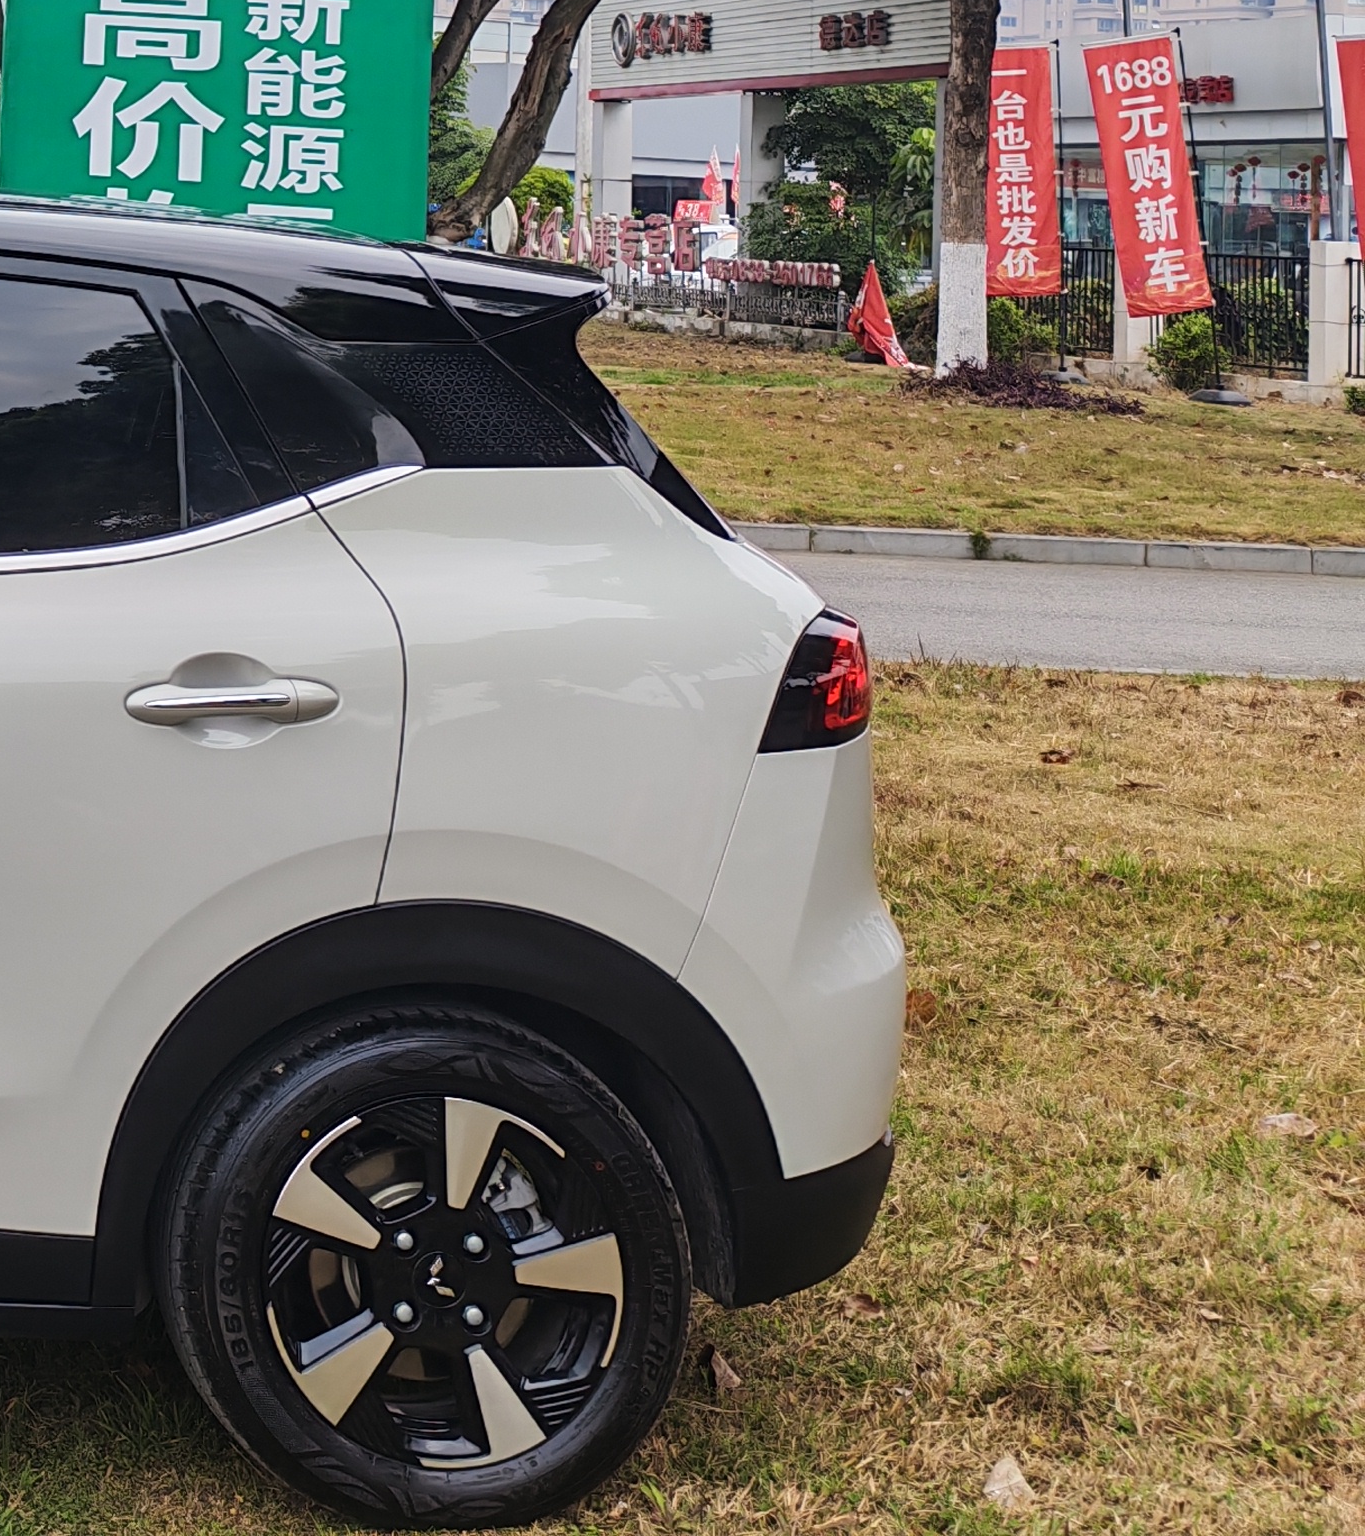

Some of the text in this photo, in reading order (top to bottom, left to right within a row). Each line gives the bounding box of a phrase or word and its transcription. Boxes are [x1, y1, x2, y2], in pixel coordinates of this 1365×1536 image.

[991, 69, 1040, 279] 一台也是批发价
